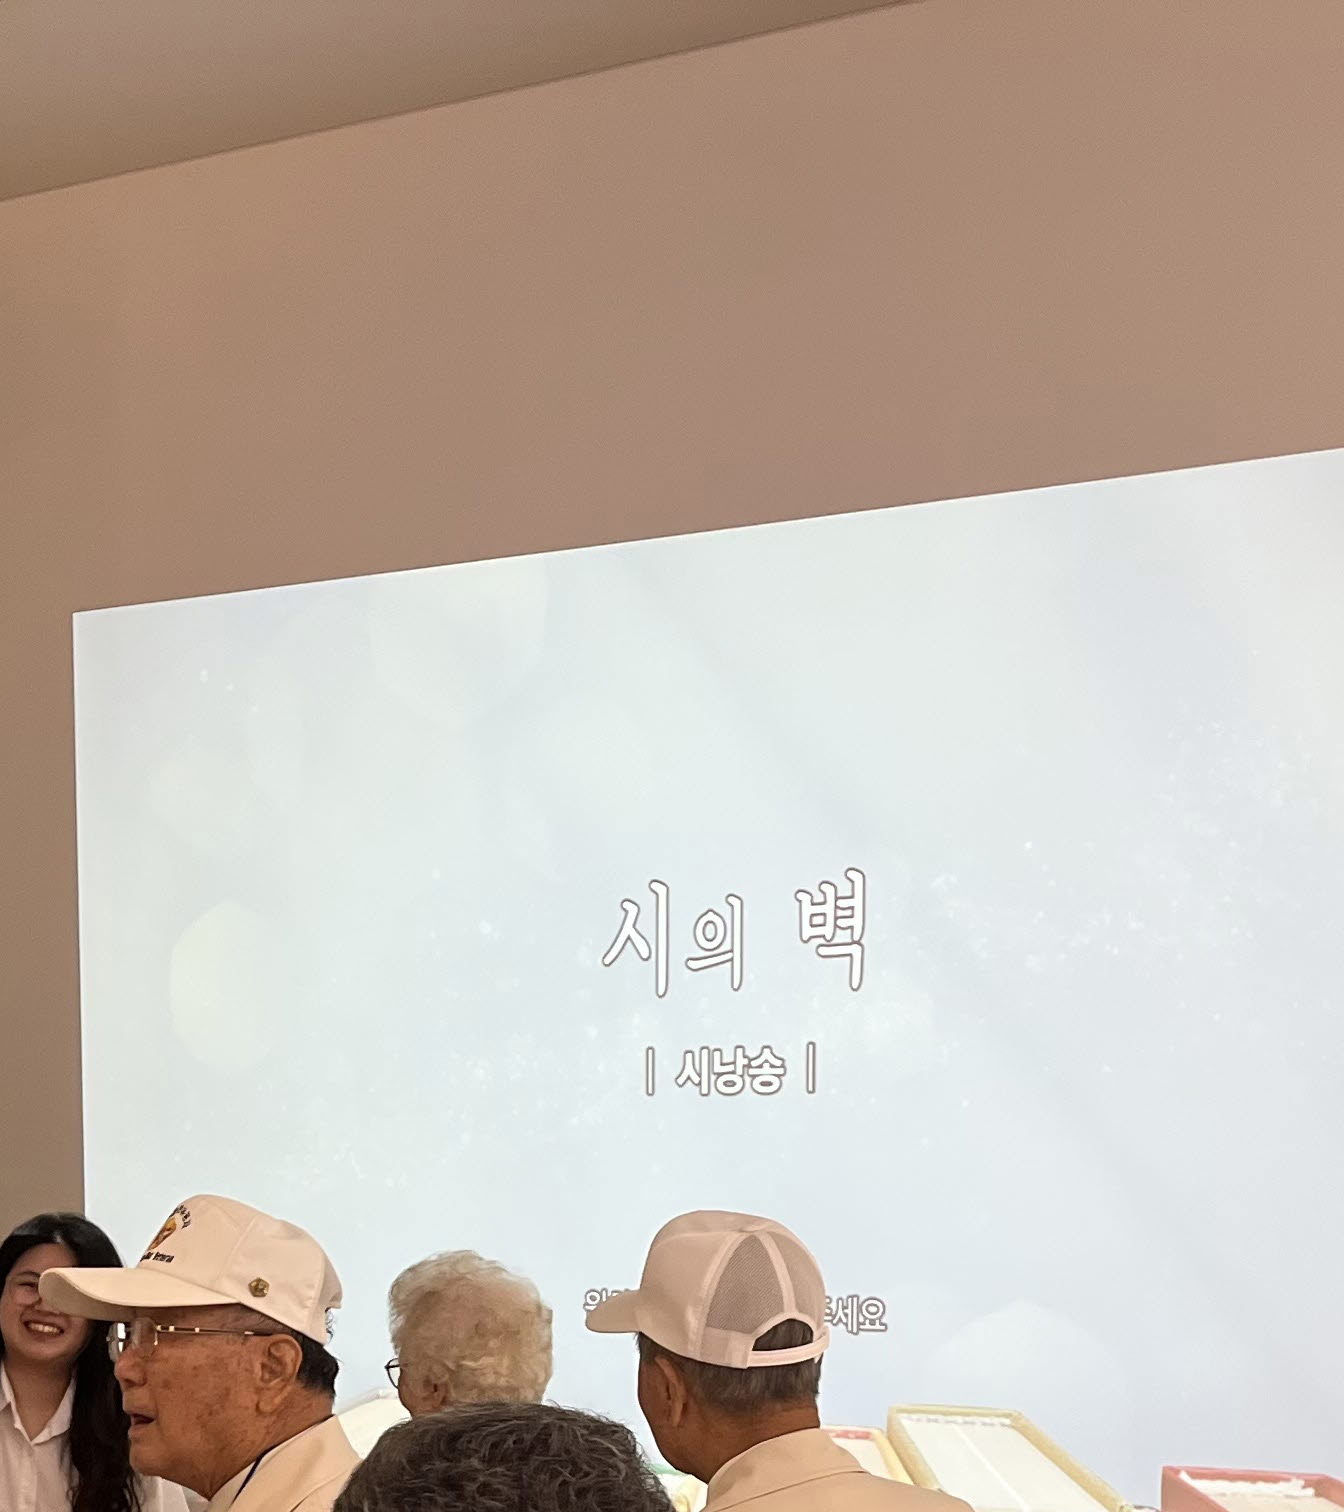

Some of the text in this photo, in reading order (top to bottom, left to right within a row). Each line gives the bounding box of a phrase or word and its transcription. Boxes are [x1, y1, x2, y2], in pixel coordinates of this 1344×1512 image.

[601, 867, 866, 998] 시의 벽
[674, 1045, 786, 1096] 시낭송
